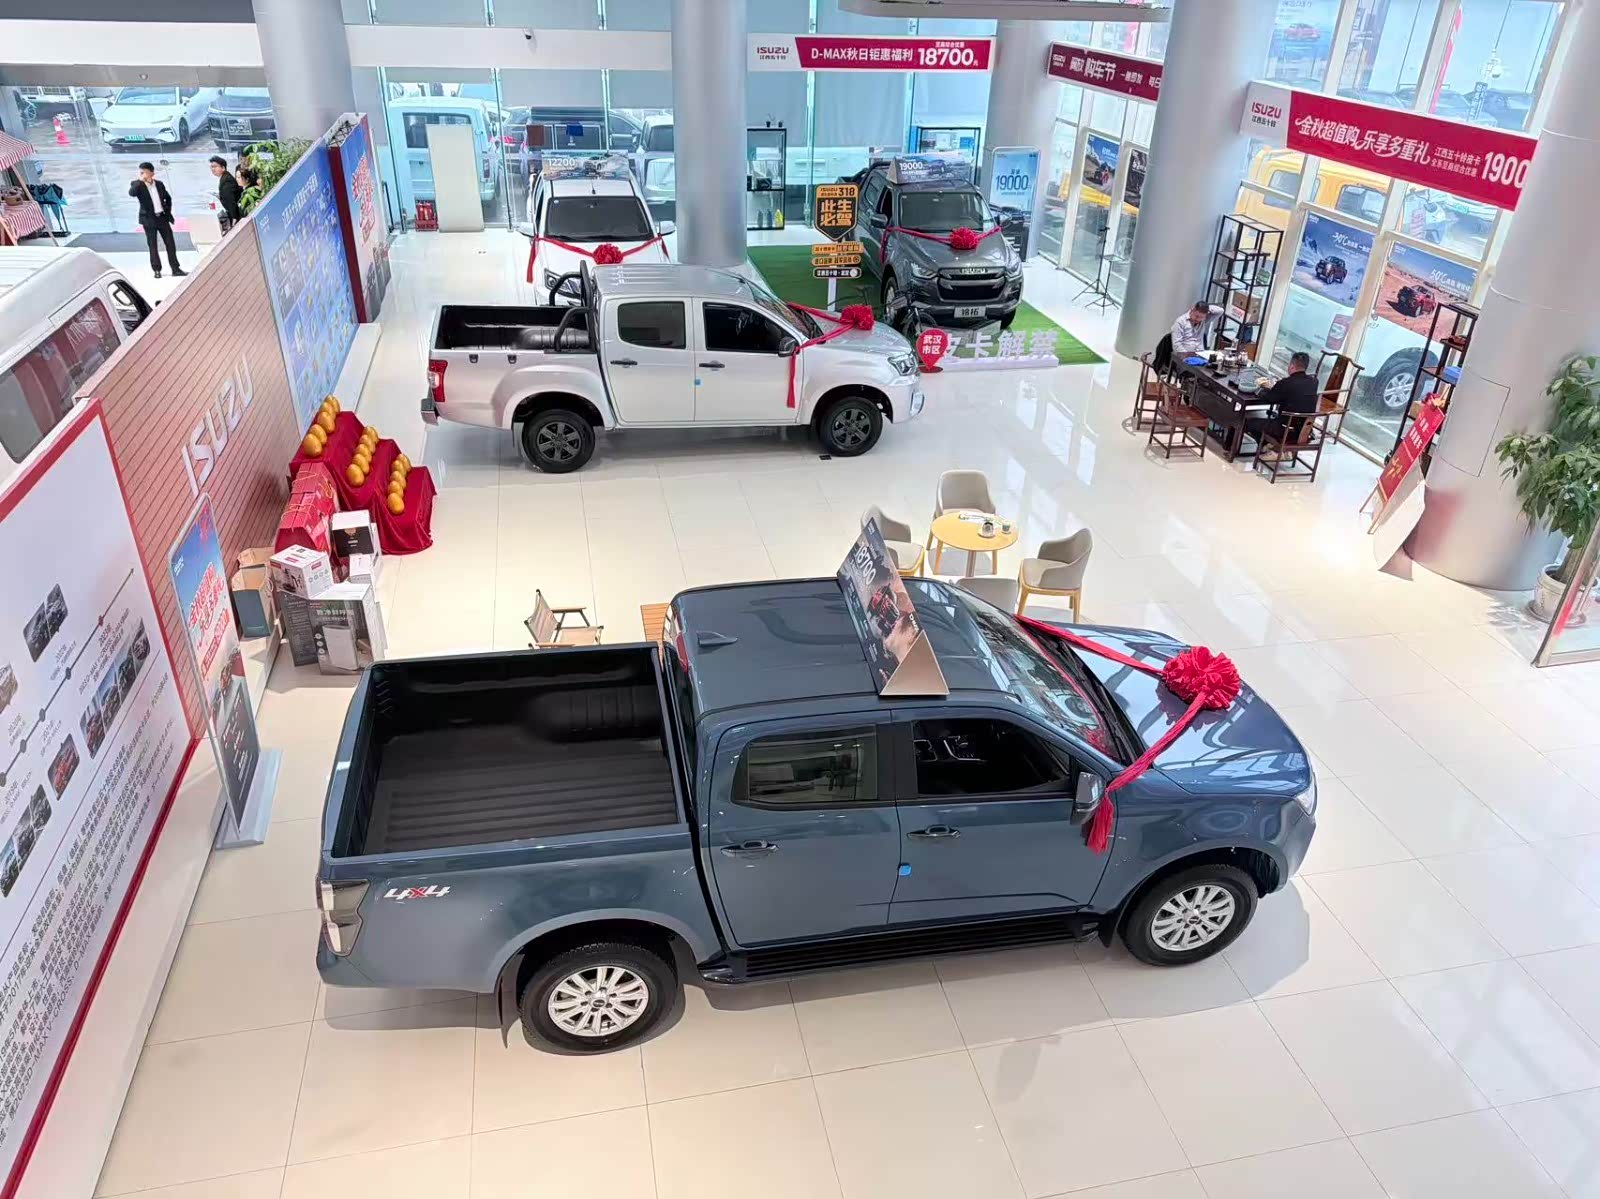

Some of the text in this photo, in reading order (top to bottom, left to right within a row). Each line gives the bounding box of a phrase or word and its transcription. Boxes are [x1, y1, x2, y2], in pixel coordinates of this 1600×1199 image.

[756, 46, 789, 54] ISUZU
[811, 47, 913, 62] D-MAX秋日钜惠福利
[1251, 102, 1282, 119] ISUZU
[900, 162, 923, 170] 19000
[996, 174, 1029, 190] 19000
[838, 187, 856, 196] 318
[820, 199, 852, 212] 此生
[820, 212, 852, 226] 必驾
[922, 334, 942, 344] 武汉
[922, 344, 941, 355] 市区
[182, 353, 254, 499] ISUZU
[854, 543, 876, 585] 18700
